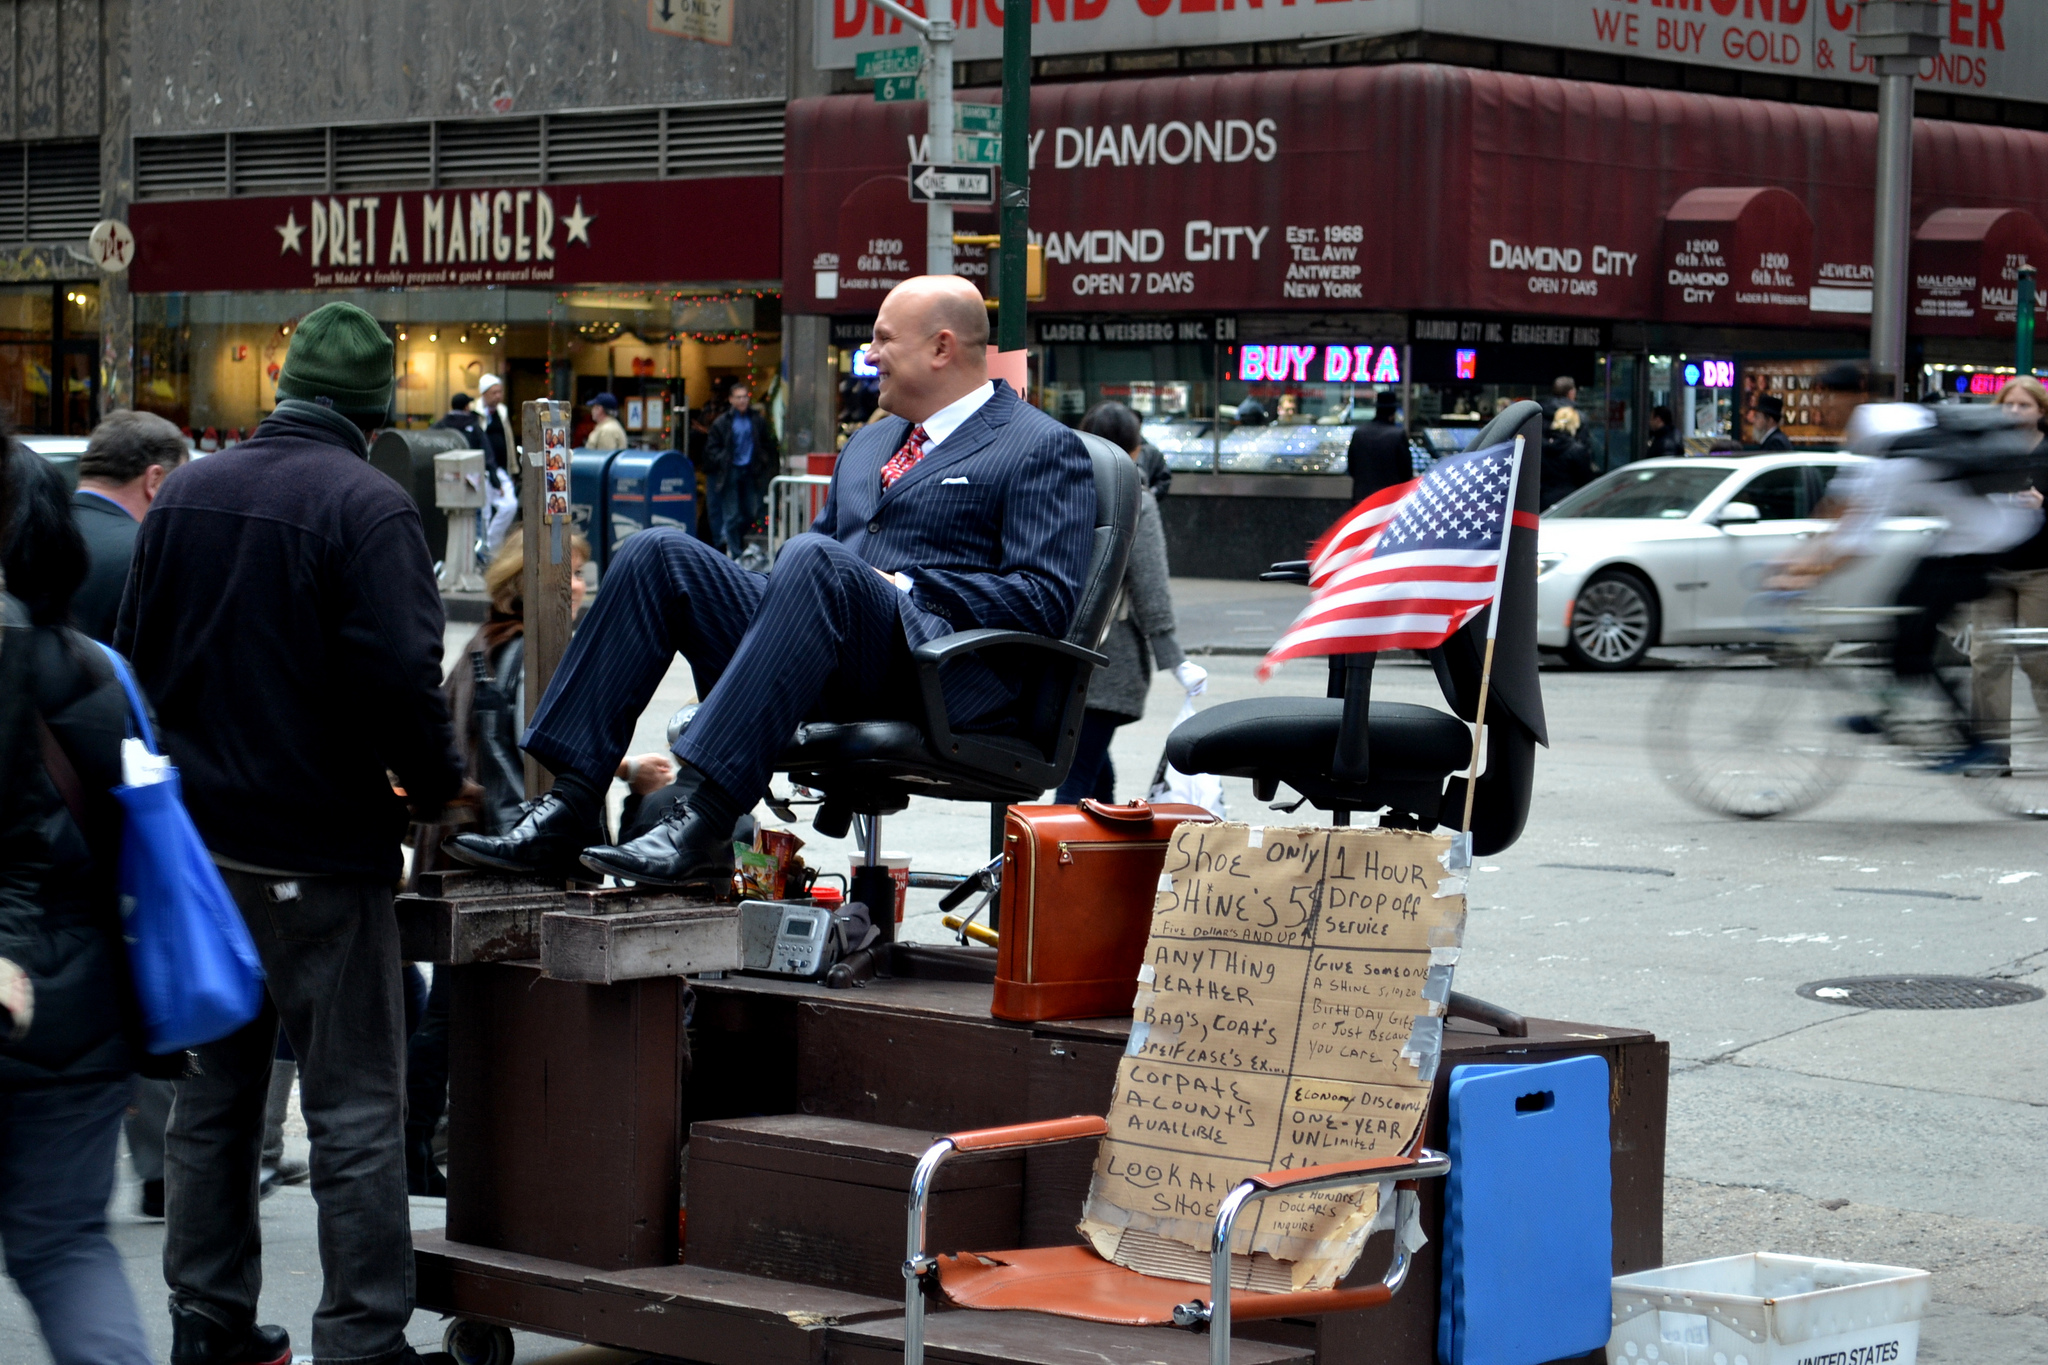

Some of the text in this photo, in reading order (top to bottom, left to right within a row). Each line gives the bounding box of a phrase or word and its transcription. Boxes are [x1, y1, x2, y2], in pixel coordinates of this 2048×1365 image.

[1592, 8, 1639, 46] WE
[1657, 18, 1706, 54] BUY
[1723, 27, 1800, 64] GOLD
[1816, 39, 1835, 70] &
[1850, 43, 1987, 87] DIONDS
[863, 57, 918, 76] AMERICAS
[883, 80, 896, 99] 6
[1055, 118, 1278, 169] DIAMONDS
[922, 175, 983, 190] ONE WAY
[311, 189, 555, 267] PRET A MANGER
[1324, 225, 1363, 243] 1968
[868, 238, 903, 256] 1200
[1184, 219, 1270, 262] CITY
[1685, 239, 1720, 253] 1200
[1290, 244, 1358, 262] TEL AVIV
[1489, 238, 1638, 276] DIAMOND CITY
[1675, 252, 1726, 268] 6th Ave.
[1760, 252, 1789, 269] 1200
[857, 255, 910, 272] 6th Ave.
[1286, 263, 1362, 280] ANTWERP
[374, 269, 404, 286] freshly
[406, 269, 447, 286] prepared
[459, 267, 483, 284] good
[495, 266, 530, 281] natural
[531, 265, 554, 281] food
[1072, 271, 1195, 295] OPEN 7 DAYS
[1668, 269, 1729, 286] DIAMOND
[1751, 268, 1795, 287] 6th Ave.
[1917, 275, 1976, 288] MALIDANI
[1284, 280, 1363, 298] NEW YORK
[1528, 276, 1598, 296] OPEN 7 DAYS
[1683, 287, 1716, 303] CITY
[1042, 320, 1208, 341] LADER & WEISBERG INC.
[1415, 319, 1600, 346] DIAMOND CITY INC. ENGAGEMENT RINGS
[1239, 344, 1400, 382] BUY DIA
[1330, 846, 1428, 889] 1 HOUR
[1243, 927, 1273, 943] AND
[1277, 931, 1297, 946] UP
[1313, 977, 1370, 995] A SHINE
[1107, 1156, 1182, 1188] LOOK
[1849, 1340, 1900, 1365] STATES
